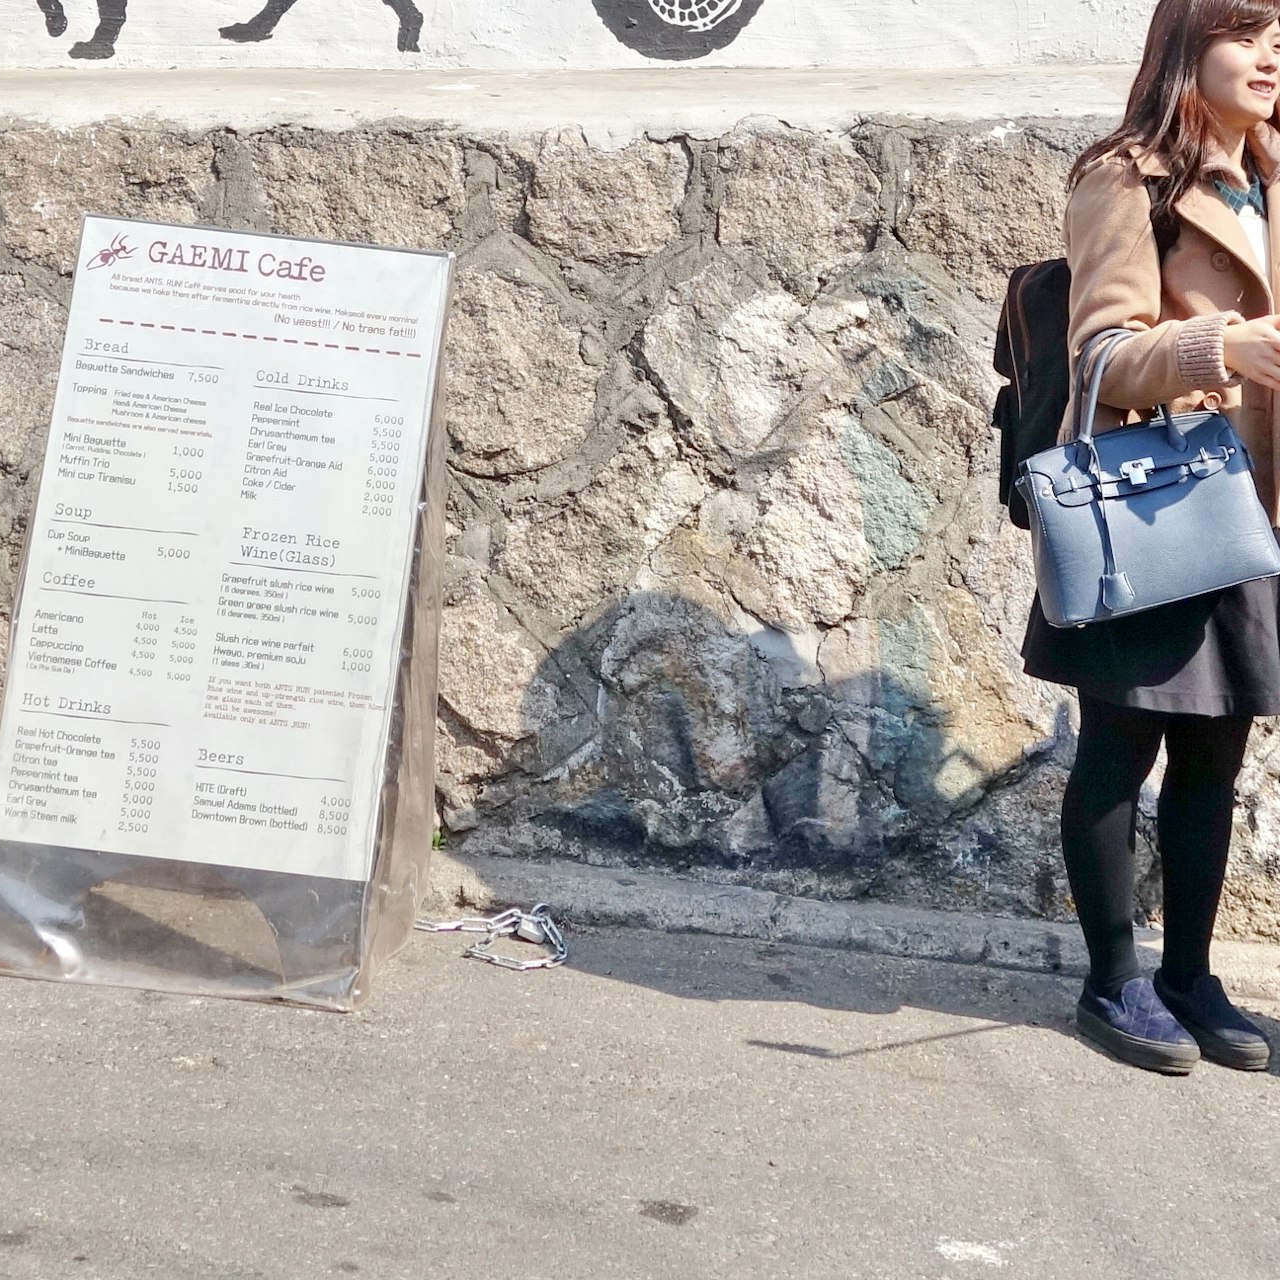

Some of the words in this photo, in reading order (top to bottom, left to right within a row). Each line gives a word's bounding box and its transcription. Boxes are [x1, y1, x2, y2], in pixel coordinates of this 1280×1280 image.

[148, 240, 251, 273] GAEMI
[257, 253, 326, 283] Cafe
[342, 321, 356, 333] No
[358, 323, 386, 336] trans
[83, 338, 129, 354] Bread
[75, 359, 119, 374] Baguette
[120, 364, 175, 380] Sandwiches
[188, 371, 219, 384] 7,500
[256, 369, 289, 385] Cold
[297, 374, 349, 391] Drinks
[251, 413, 301, 428] Peppermint
[372, 426, 402, 439] 5,500
[253, 400, 273, 412] Real
[273, 403, 288, 414] Ice
[289, 405, 334, 419] Chocolate
[374, 414, 404, 426] 6,000
[63, 431, 82, 443] Mini
[83, 433, 127, 448] Baguette
[172, 445, 204, 458] 1,000
[247, 438, 266, 450] Earl
[266, 440, 288, 453] Grey
[369, 452, 399, 465] 5,000
[313, 433, 336, 445] tea
[371, 439, 401, 452] 5,500
[59, 453, 91, 466] Muffin
[92, 457, 111, 469] Trio
[169, 467, 203, 481] 5,000
[243, 463, 271, 476] Citron
[272, 467, 288, 478] Aid
[365, 478, 396, 491] 6,000
[327, 460, 344, 471] Aid
[367, 465, 398, 478] 6,000
[57, 467, 76, 479] Mini
[77, 471, 96, 481] cup
[97, 471, 137, 486] Tiramisu
[167, 481, 199, 494] 1,500
[242, 476, 264, 488] Coke
[273, 480, 297, 492] Cider
[363, 491, 394, 504] 2,000
[54, 502, 92, 521] Soup
[240, 489, 257, 501] Milk
[361, 504, 392, 517] 2,000
[47, 528, 66, 540] Cup
[67, 530, 91, 544] Soup
[241, 526, 297, 545] Frozen
[305, 533, 341, 550] Rice
[157, 546, 191, 560] 5,000
[240, 544, 336, 568] Wine(Glass)
[42, 571, 96, 589] Coffee
[221, 572, 268, 587] Grapefruit
[269, 578, 294, 590] slush
[294, 581, 313, 592] rice
[314, 584, 335, 595] wine
[351, 587, 381, 600] 5,000
[33, 608, 84, 624] Americano
[135, 622, 160, 632] 4,000
[173, 626, 198, 636] 4,500
[31, 622, 59, 635] Latte
[132, 636, 158, 646] 4,500
[171, 640, 196, 650] 5,000
[215, 632, 240, 644] Slush
[241, 635, 260, 646] rice
[261, 638, 282, 649] wine
[282, 641, 315, 653] parfait
[342, 647, 373, 660] 6,000
[29, 636, 85, 653] Cappuccino
[131, 650, 156, 660] 4,500
[169, 654, 194, 665] 5,000
[22, 692, 50, 708] Hot
[57, 696, 112, 715] Drinks
[16, 725, 38, 737] Real
[38, 728, 55, 740] Hot
[56, 730, 102, 745] Chocolate
[131, 738, 161, 751] 5,500
[197, 748, 245, 766] Beers
[195, 781, 215, 794] HITE
[216, 784, 247, 797] (Draft)
[320, 795, 352, 809] 4,000
[193, 795, 226, 808] Samuel
[226, 799, 257, 812] Adams
[259, 802, 298, 817] (bottled)
[318, 809, 350, 822] 8,500
